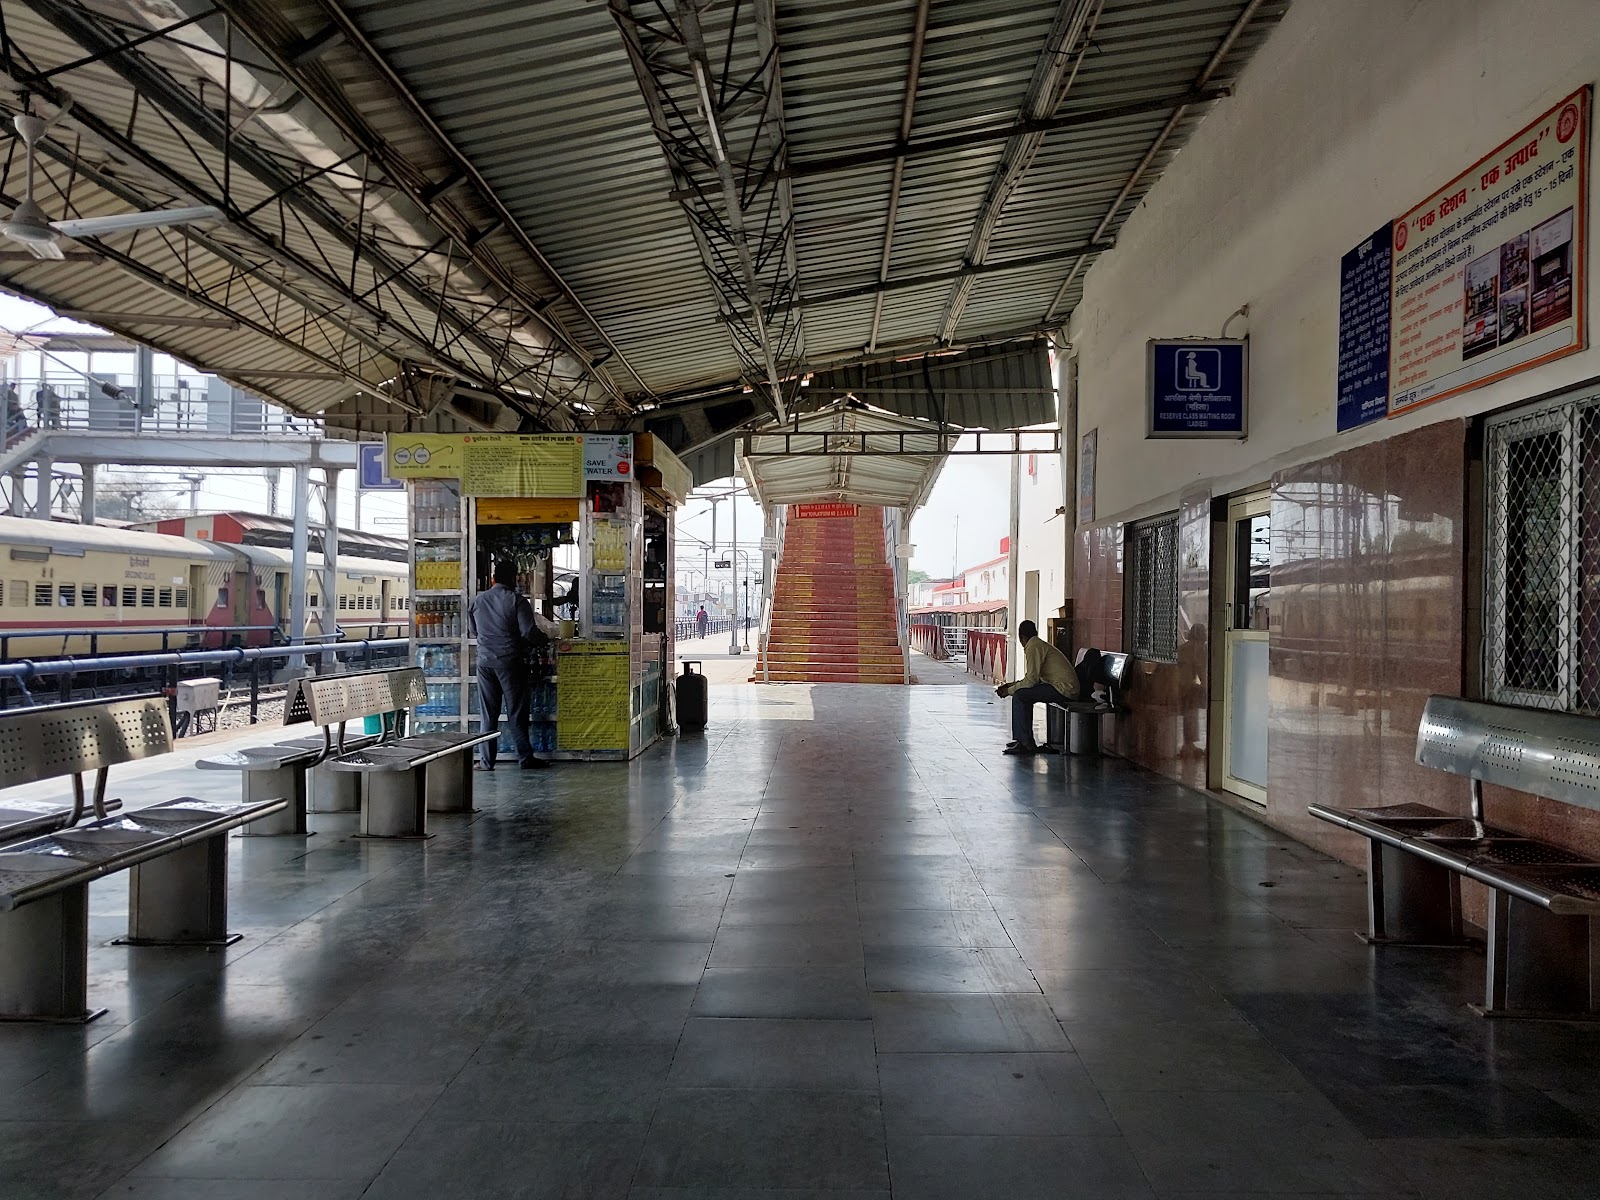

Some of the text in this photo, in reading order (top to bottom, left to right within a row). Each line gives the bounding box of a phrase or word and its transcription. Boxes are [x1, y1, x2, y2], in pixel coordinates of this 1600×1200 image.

[1440, 189, 1466, 218] स्टेशन
[1481, 166, 1500, 190] एक
[1396, 255, 1407, 267] भारत
[1408, 244, 1423, 260] सरकार
[1424, 237, 1430, 249] की
[1431, 234, 1439, 247] इस
[1440, 224, 1455, 239] योजना
[1457, 217, 1462, 229] के
[1484, 195, 1500, 212] स्टेशन
[1501, 189, 1509, 200] पर
[1511, 179, 1521, 195] रखे
[1522, 174, 1533, 188] एक
[1534, 161, 1554, 180] स्टेशन
[1562, 147, 1575, 163] एक
[1396, 270, 1408, 283] उत्पाद
[1420, 257, 1425, 267] के
[1426, 249, 1441, 264] माध्यम
[1442, 243, 1448, 255] से
[1448, 237, 1460, 251] निम्न
[1462, 225, 1481, 243] स्थानीय
[1500, 206, 1508, 219] की
[1524, 193, 1533, 207] हेतु
[1534, 188, 1542, 198] 15
[1549, 178, 1557, 190] 15
[1558, 165, 1574, 184] दिनों
[1395, 287, 1400, 298] के
[1400, 284, 1409, 295] लिए
[1410, 275, 1425, 290] आवेदन
[1188, 393, 1202, 402] श्रेणी
[1185, 402, 1210, 412] (महिला)
[1160, 412, 1236, 420] RESERVE CLASS WAITING ROOM
[1186, 420, 1208, 428] (LADIES)
[124, 570, 156, 580] SECOND CLASS
